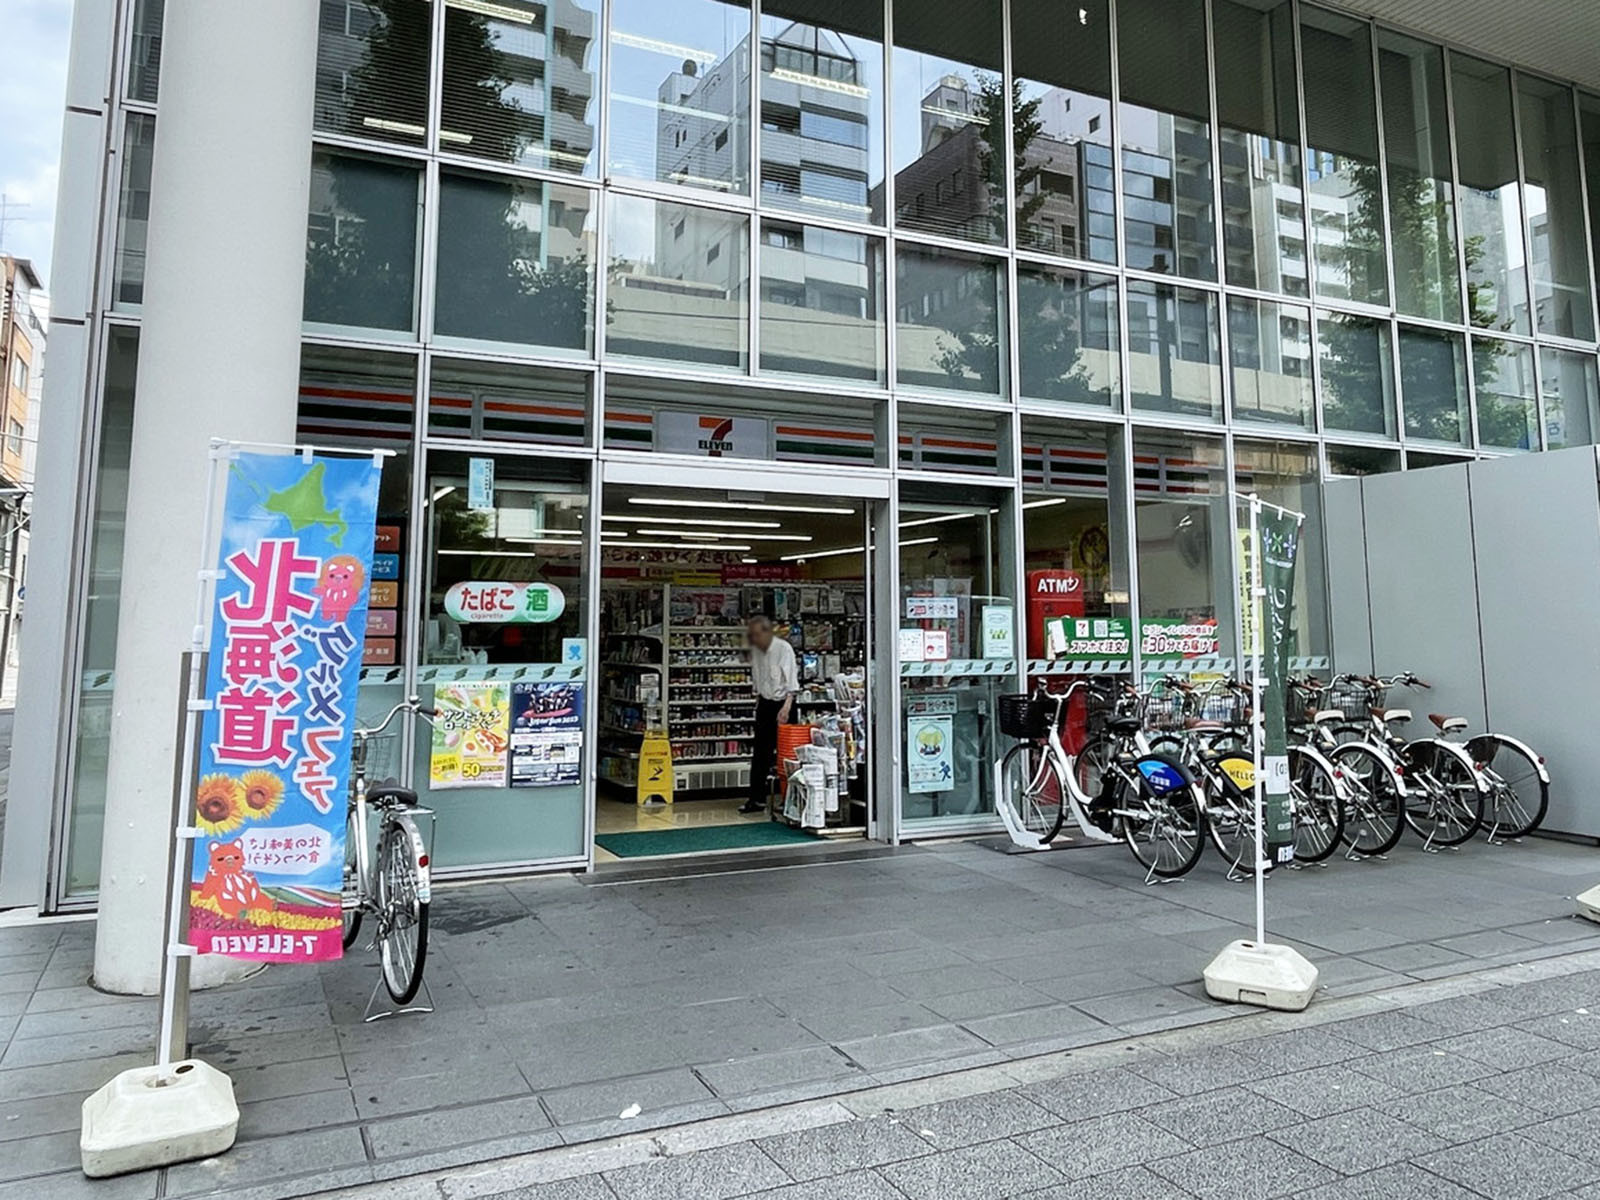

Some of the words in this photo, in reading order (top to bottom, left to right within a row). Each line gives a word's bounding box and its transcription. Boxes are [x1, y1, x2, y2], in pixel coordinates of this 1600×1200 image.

[1037, 578, 1068, 593] ATM
[460, 588, 515, 611] たばこ
[525, 588, 549, 612] 酒
[463, 762, 480, 777] 50
